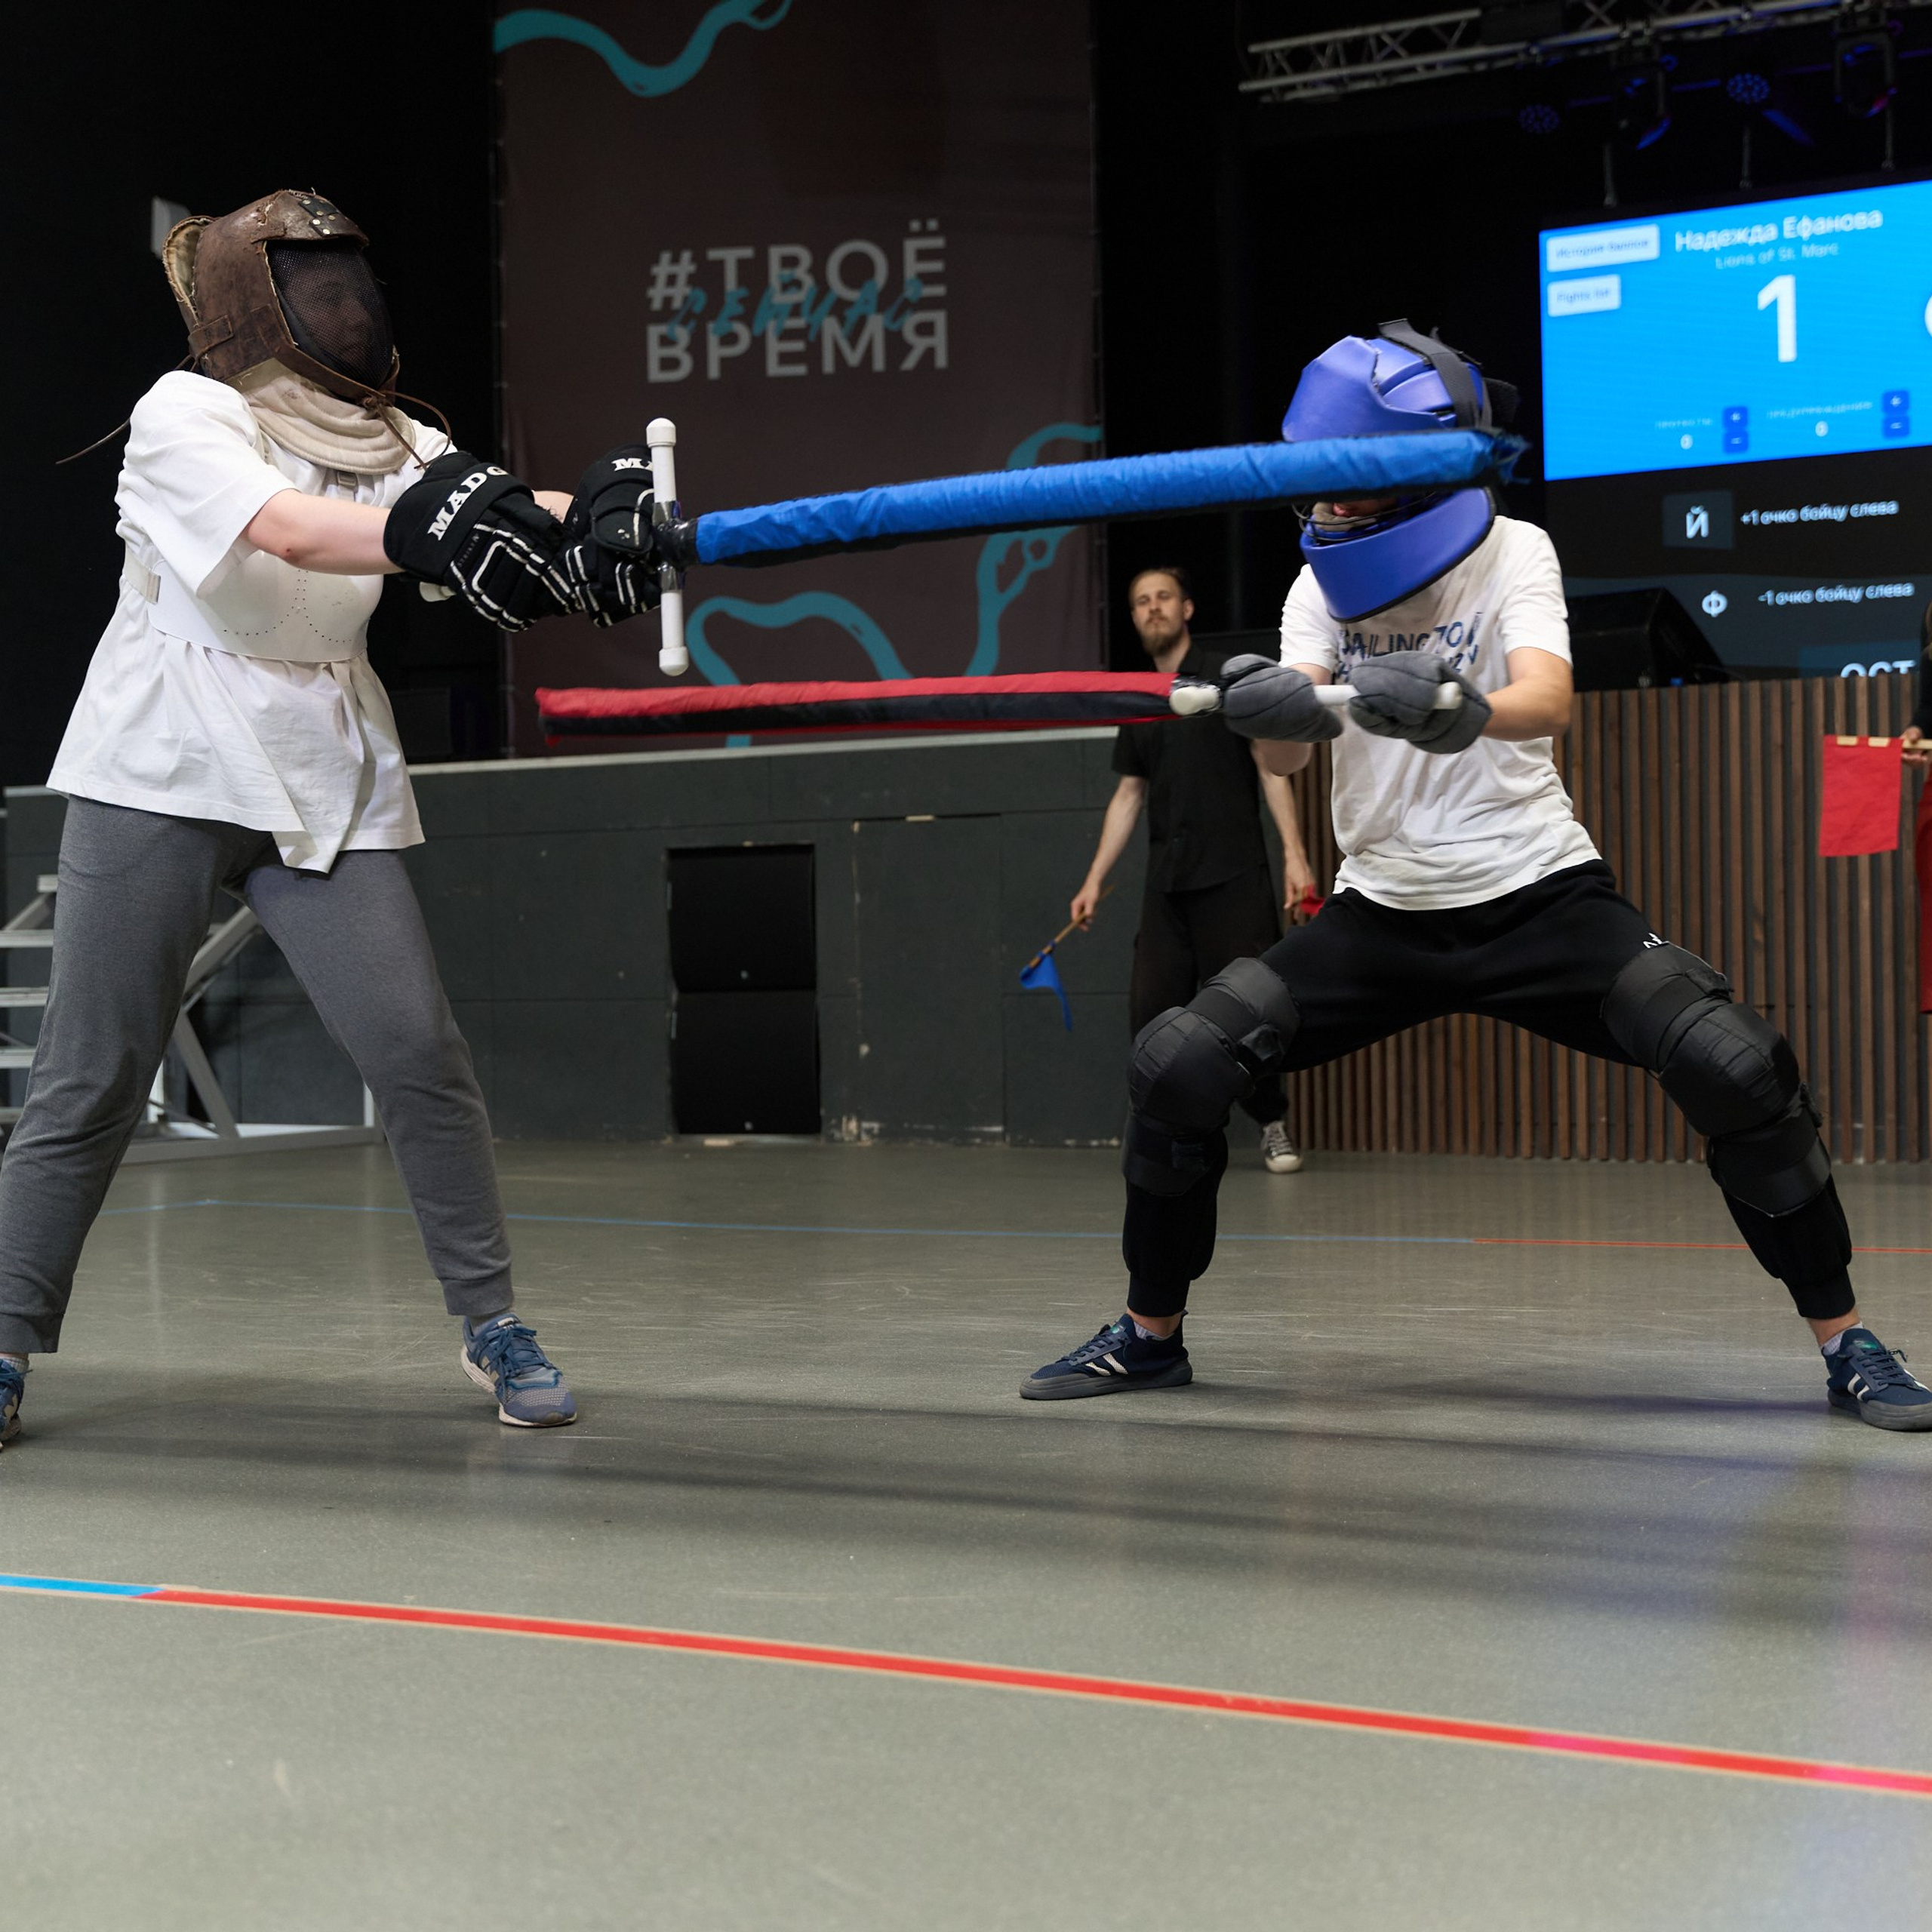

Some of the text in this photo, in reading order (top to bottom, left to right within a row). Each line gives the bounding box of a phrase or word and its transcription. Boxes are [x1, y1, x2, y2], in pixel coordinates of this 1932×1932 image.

[1675, 210, 1883, 252] Надежда Ефанова
[647, 219, 946, 311] #ТВОЁ
[1758, 274, 1797, 362] 1
[647, 309, 949, 383] ВРЕМЯ
[1686, 505, 1709, 539] Й
[1740, 500, 1900, 525] +1 очко бойцу слева
[1702, 589, 1727, 617] Ф
[1775, 589, 1814, 605] очко
[1815, 584, 1864, 603] бойцу
[1866, 583, 1915, 598] слева
